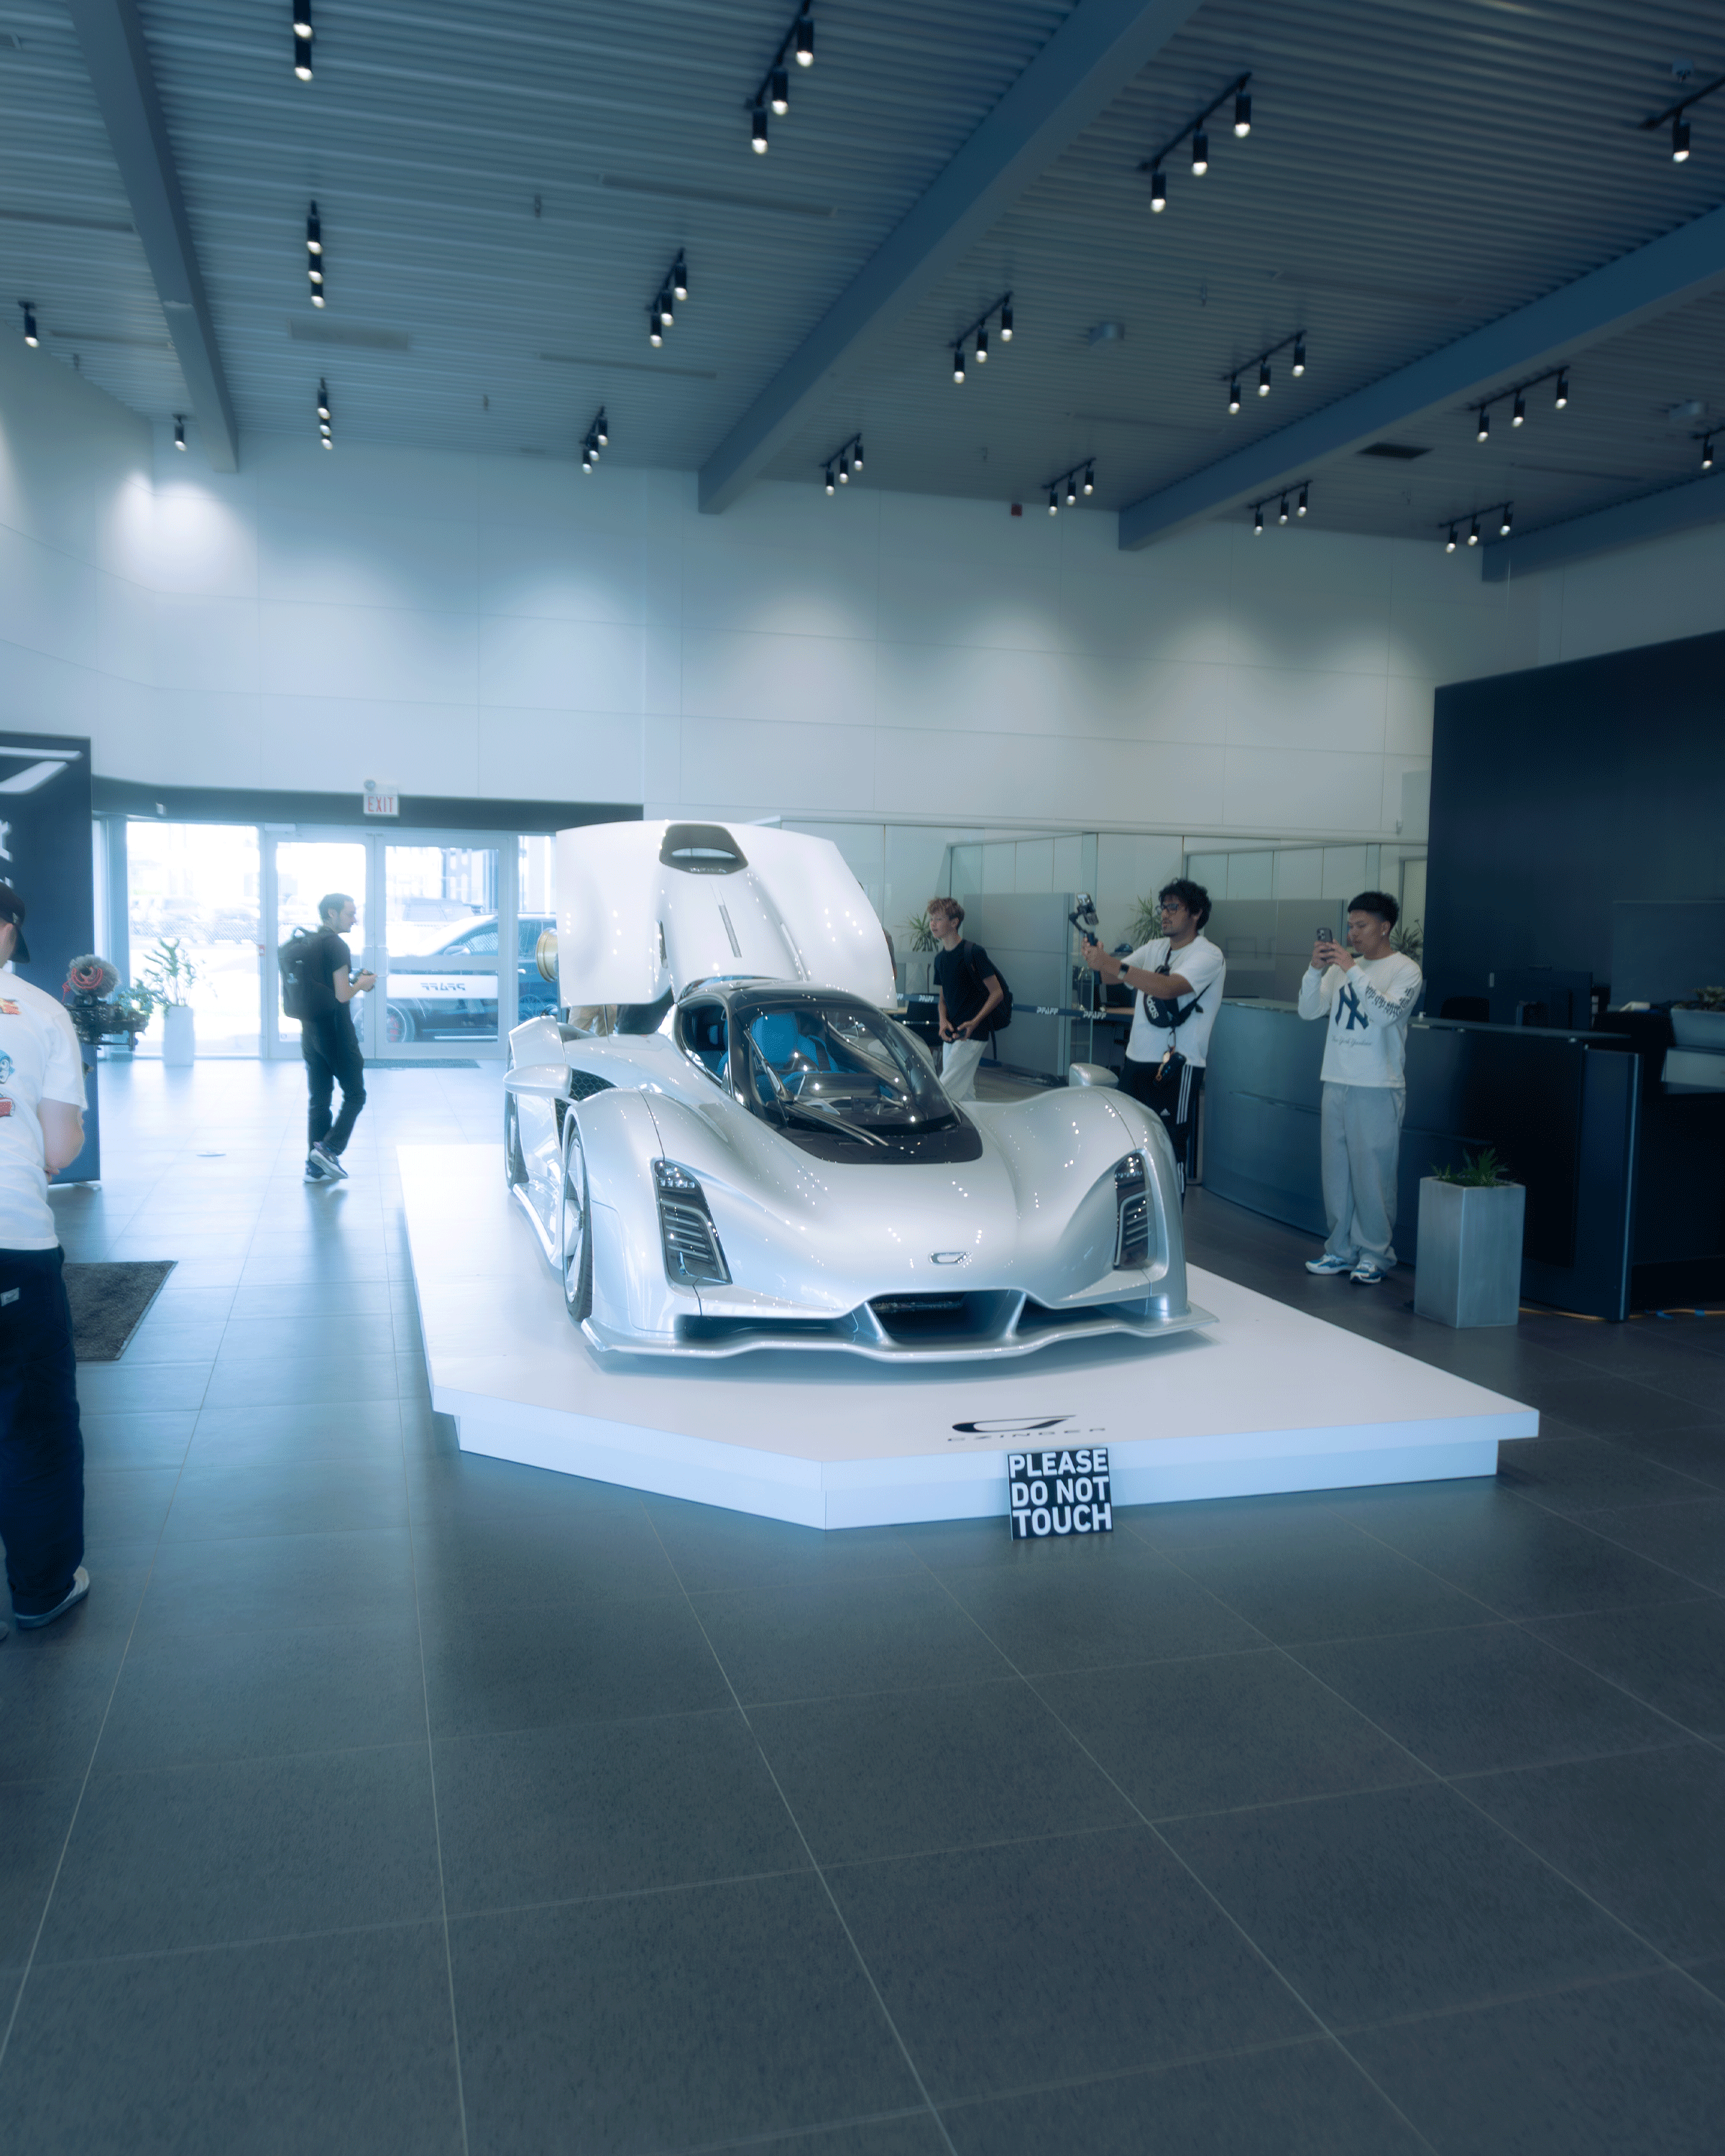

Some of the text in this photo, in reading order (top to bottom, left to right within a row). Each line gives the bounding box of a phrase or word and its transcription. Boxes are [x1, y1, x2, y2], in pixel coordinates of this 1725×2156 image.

[368, 796, 393, 813] EXIT
[1036, 1006, 1059, 1015] PFAFF
[1083, 1010, 1107, 1020] PFAFF
[1008, 1448, 1108, 1478] PLEASE
[1011, 1475, 1110, 1508] DO NOT
[1012, 1502, 1113, 1537] TOUCH
